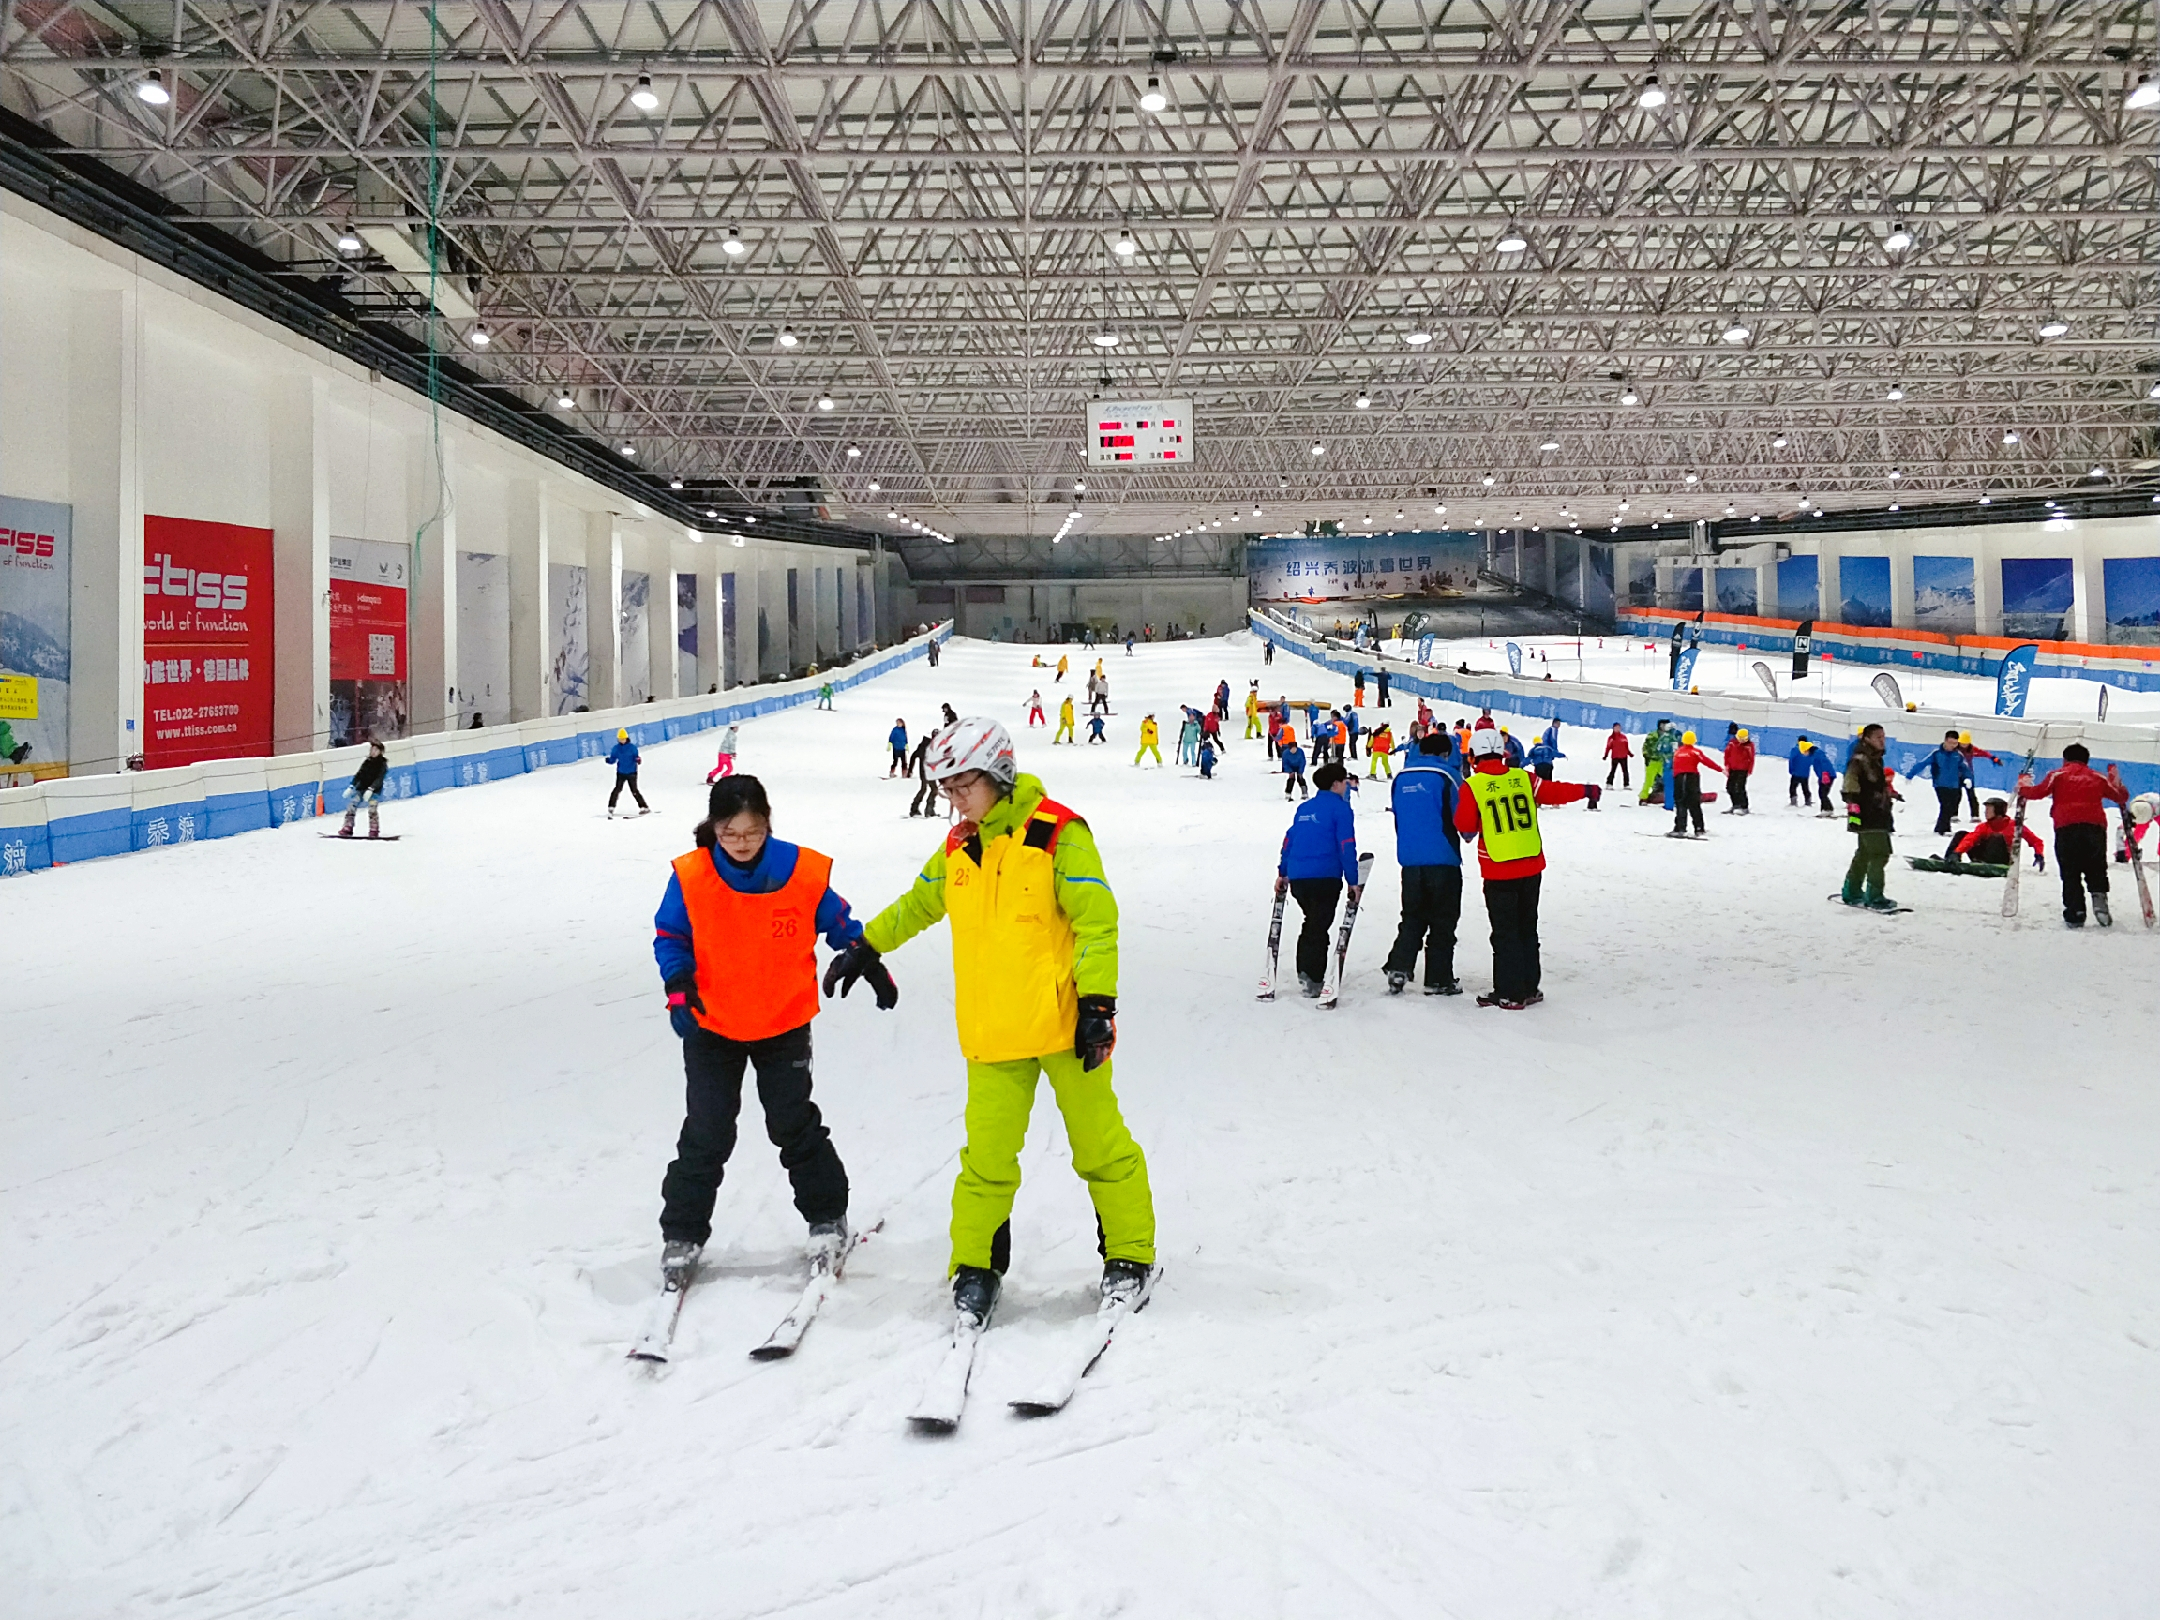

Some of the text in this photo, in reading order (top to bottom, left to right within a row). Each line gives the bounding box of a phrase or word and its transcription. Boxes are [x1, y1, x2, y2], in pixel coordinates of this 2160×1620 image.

[1286, 556, 1432, 577] 绍兴乔波冰雪世界
[179, 611, 192, 631] of
[196, 611, 249, 632] function
[1486, 778, 1523, 792] 乔波
[1485, 792, 1533, 835] 119
[771, 918, 798, 938] 26
